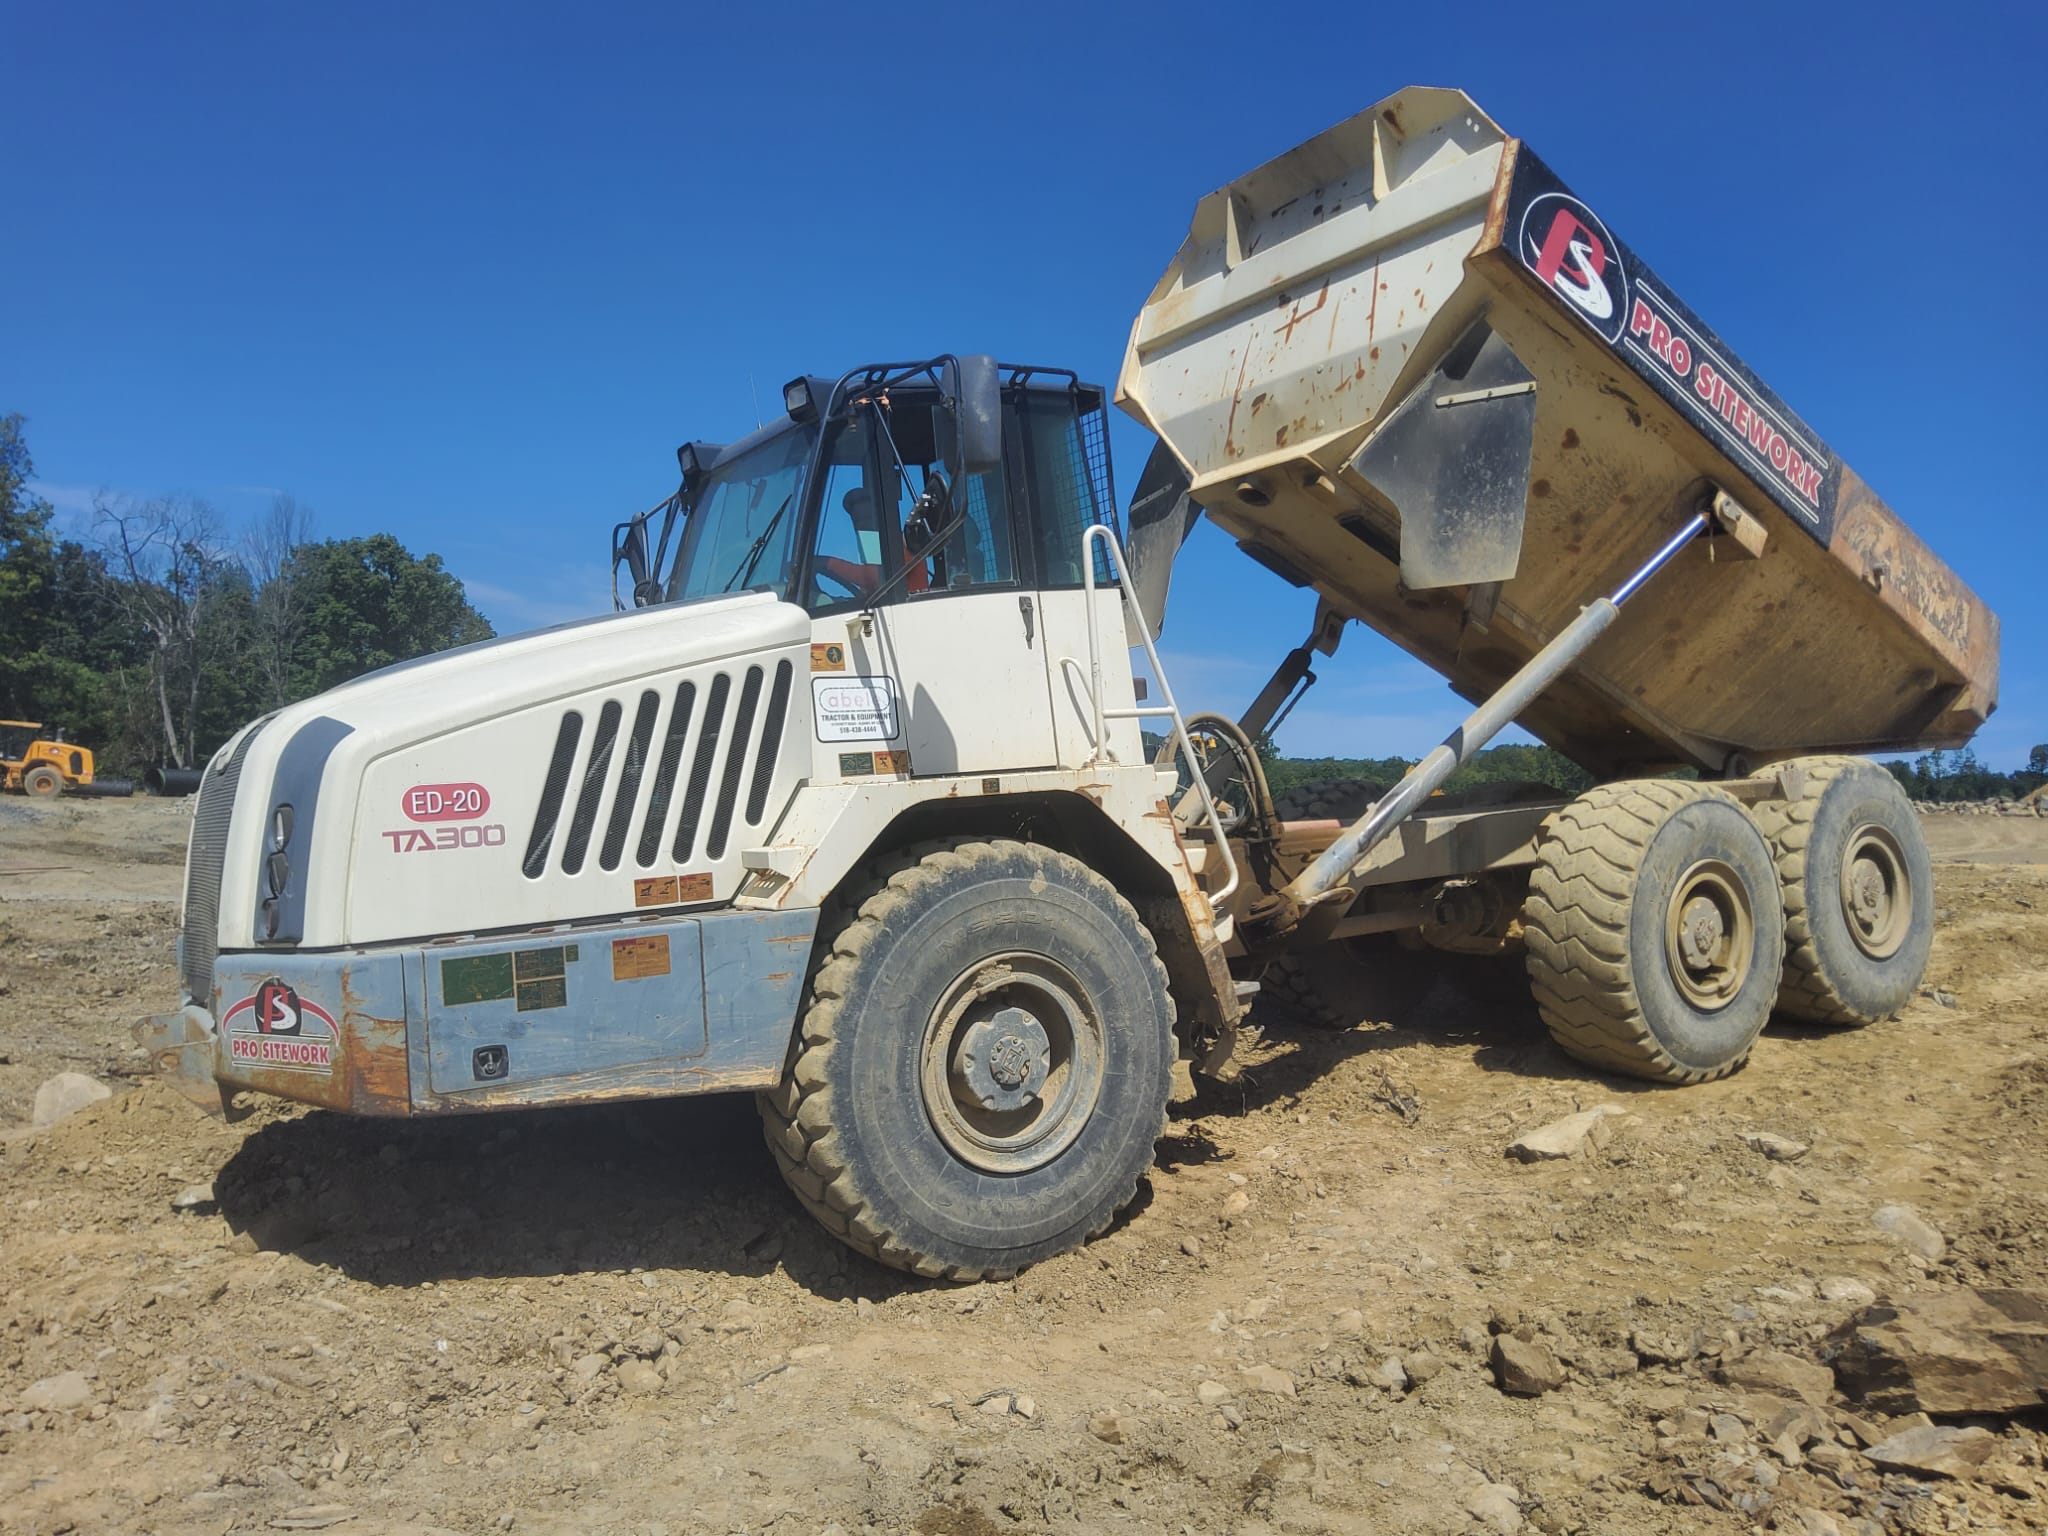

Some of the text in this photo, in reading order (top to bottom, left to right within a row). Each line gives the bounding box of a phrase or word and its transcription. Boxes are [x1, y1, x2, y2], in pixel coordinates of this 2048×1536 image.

[1629, 297, 1823, 508] PRO SITEWORK
[411, 788, 482, 815] ED-20
[382, 824, 506, 853] TA300
[232, 1039, 330, 1065] PRO SITEWORK
